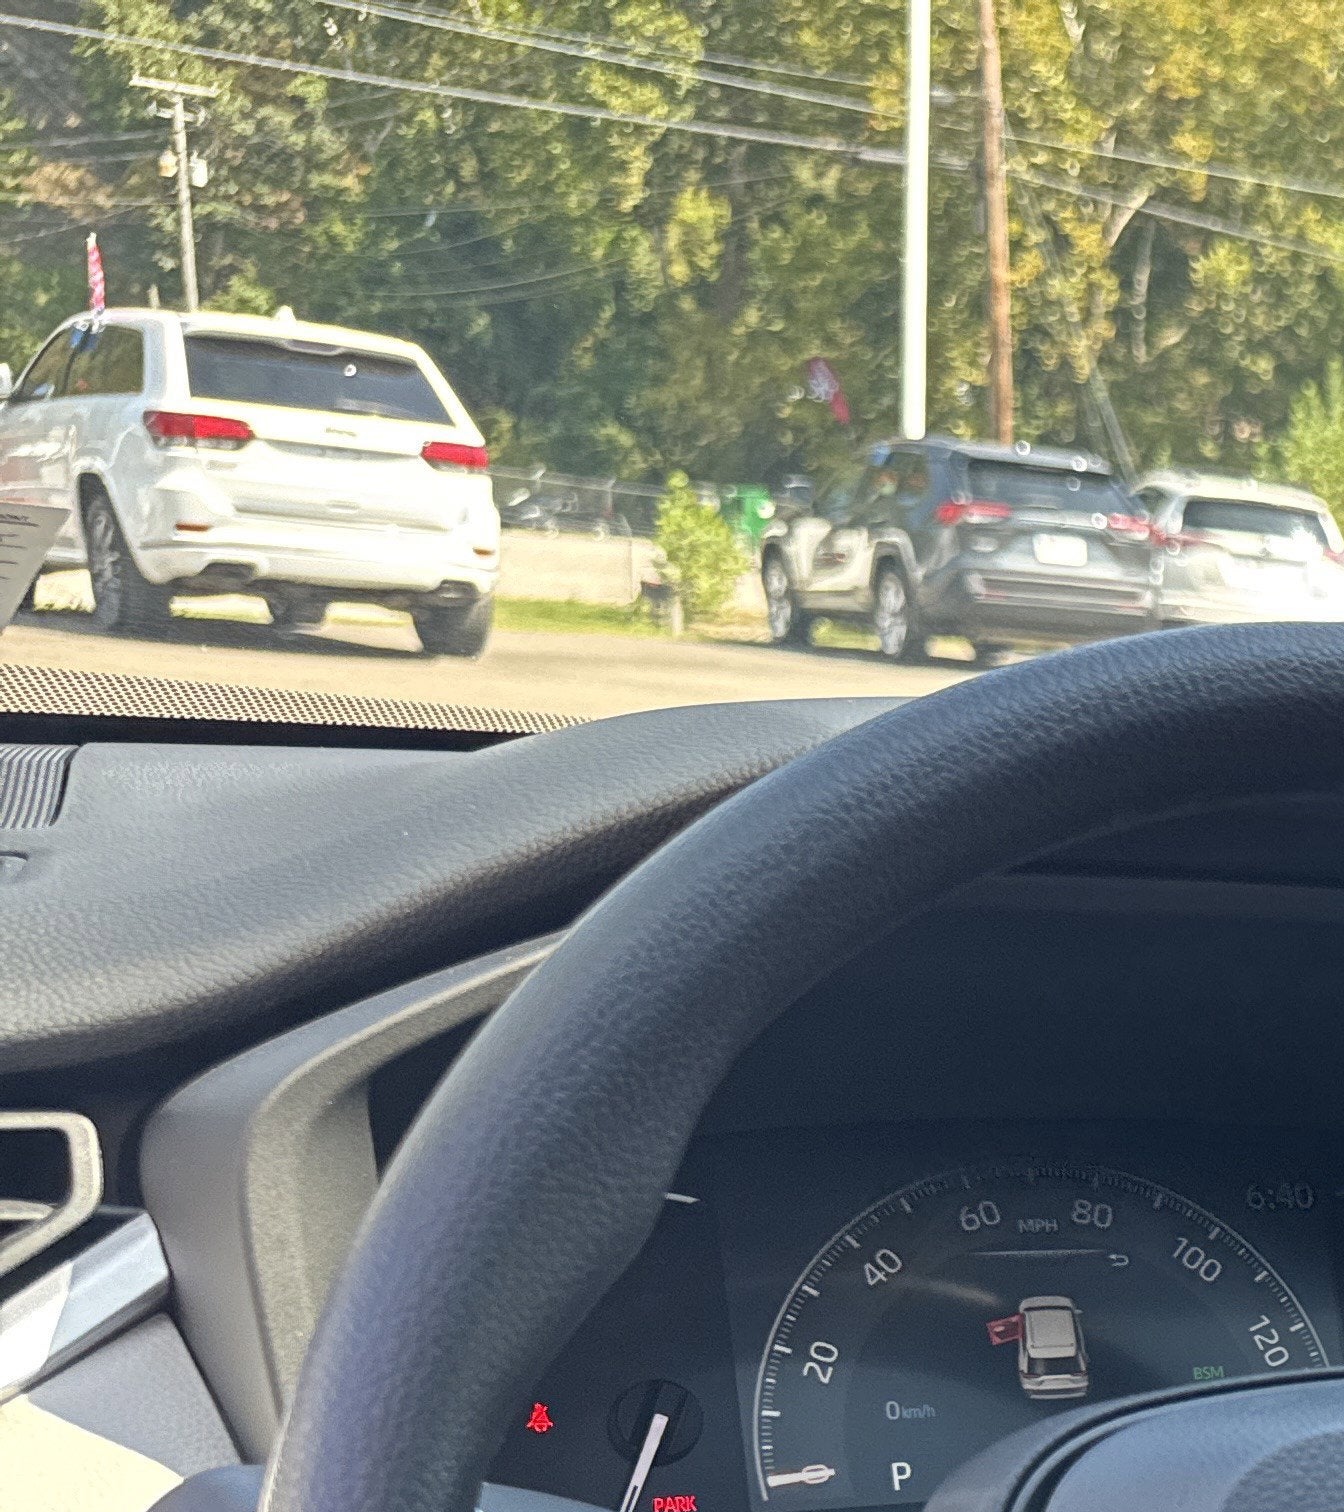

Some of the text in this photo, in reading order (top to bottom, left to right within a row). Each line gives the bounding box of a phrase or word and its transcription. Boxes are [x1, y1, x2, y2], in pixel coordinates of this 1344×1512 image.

[1246, 1184, 1315, 1211] 6:40
[958, 1200, 1002, 1233] 60
[1017, 1217, 1059, 1235] MPH
[1070, 1199, 1114, 1231] 80
[862, 1247, 903, 1288] 40
[1170, 1236, 1223, 1284] 100
[1247, 1314, 1291, 1368] 120
[802, 1340, 839, 1384] 20
[1193, 1365, 1225, 1381] BSM
[891, 1462, 912, 1491] P
